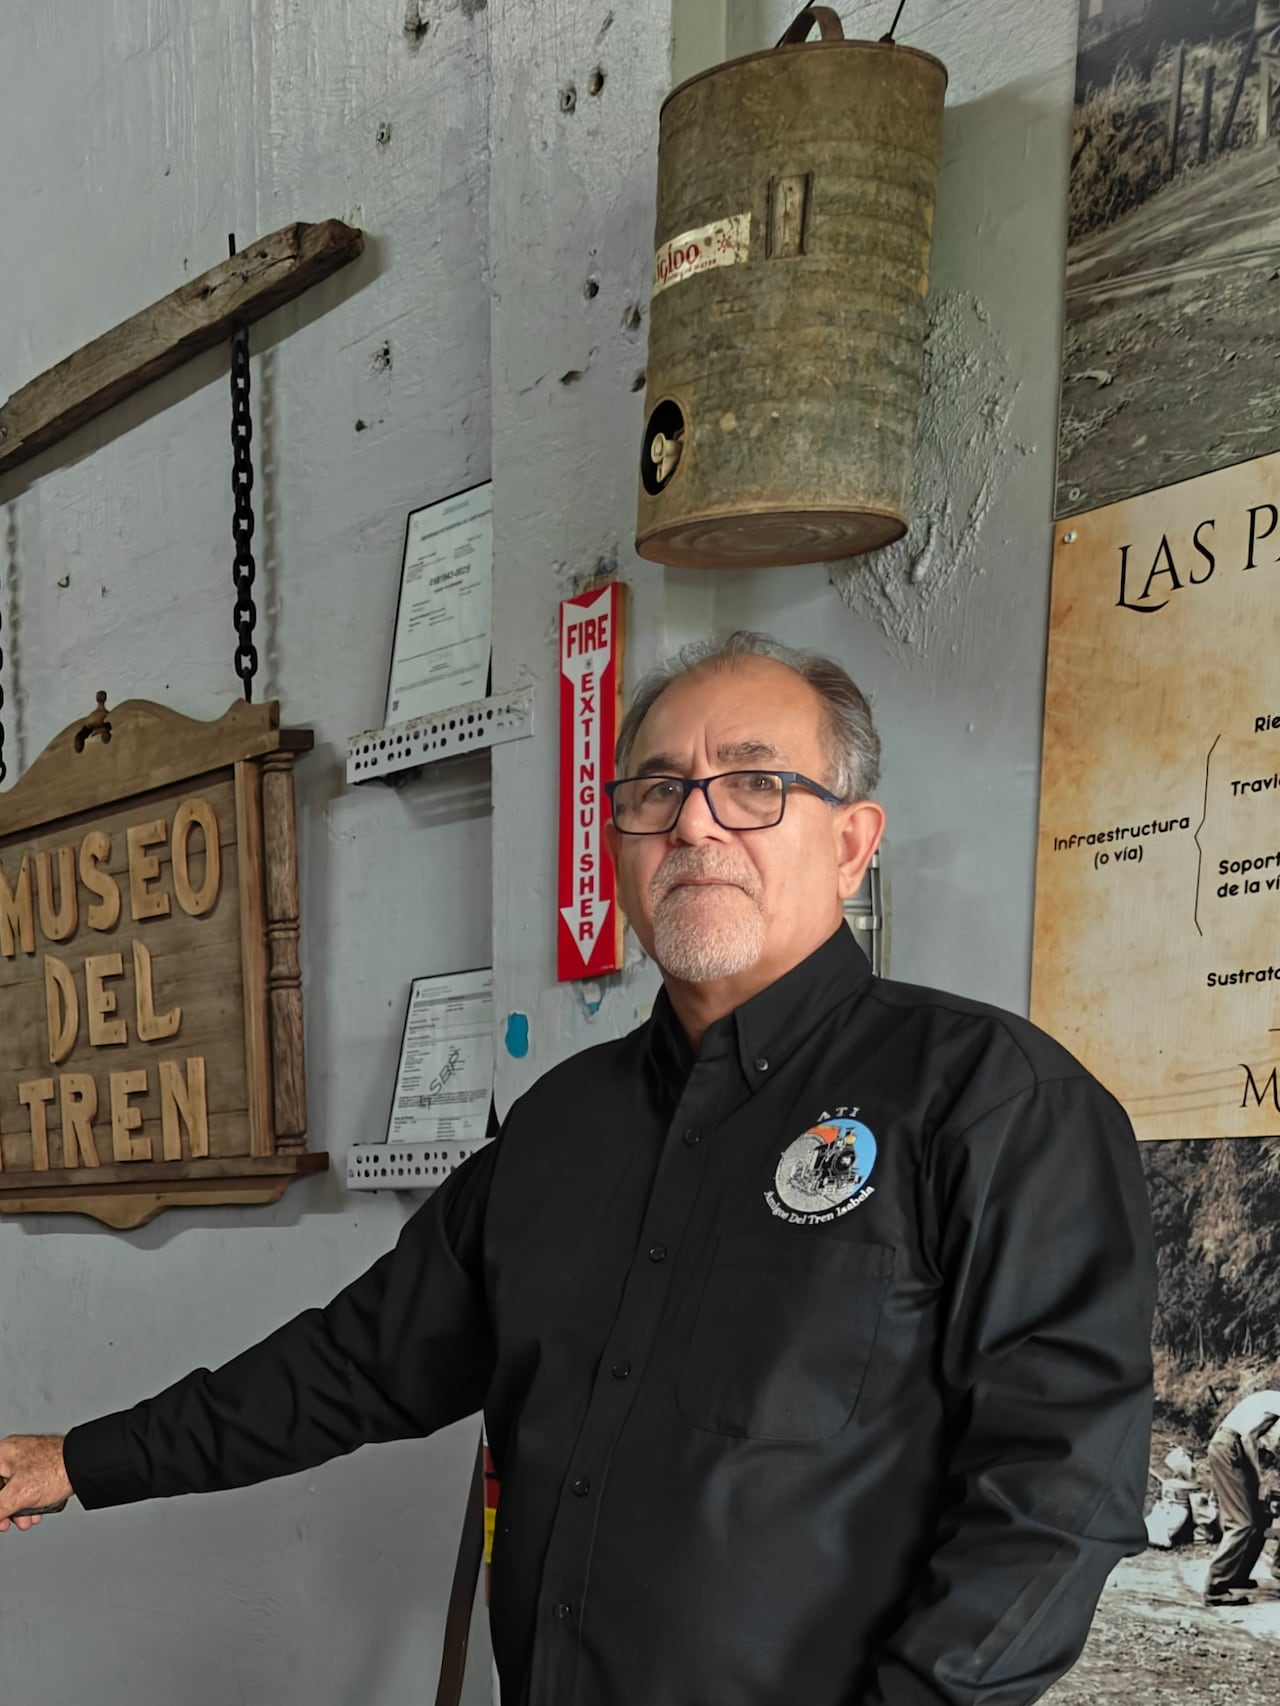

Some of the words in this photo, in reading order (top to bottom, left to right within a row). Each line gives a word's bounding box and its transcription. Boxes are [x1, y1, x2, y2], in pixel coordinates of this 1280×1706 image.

[1115, 518, 1216, 613] LAS
[567, 613, 608, 659] FIRE
[1231, 773, 1280, 796] Travi
[579, 671, 595, 942] EXTINGUISHER
[1053, 816, 1190, 851] Infraestructura
[1094, 851, 1110, 870] (o
[1114, 844, 1144, 863] vía)
[1217, 882, 1239, 898] de
[1244, 879, 1260, 895] la
[44, 939, 182, 1064] DEL
[18, 1056, 209, 1172] TREN
[788, 1213, 807, 1225] Del
[808, 1212, 834, 1225] Tren
